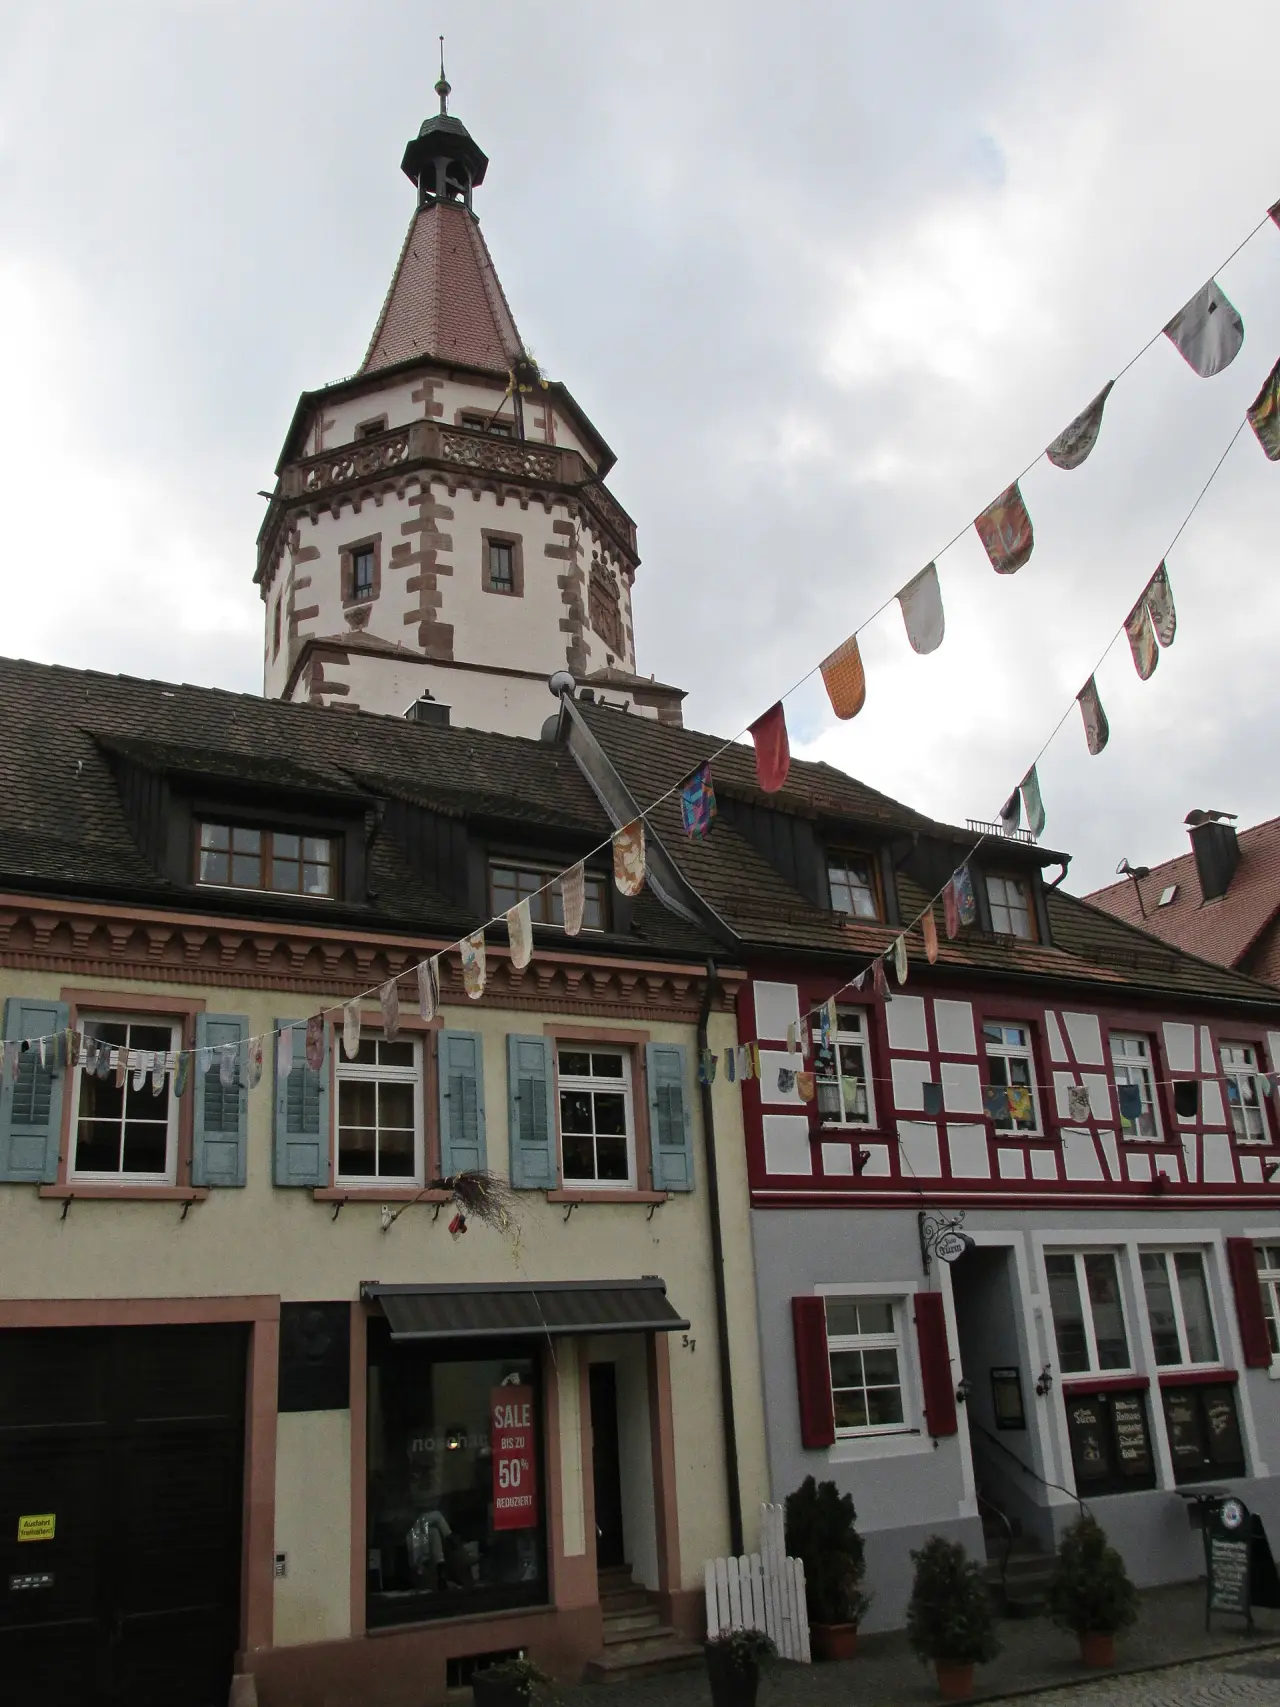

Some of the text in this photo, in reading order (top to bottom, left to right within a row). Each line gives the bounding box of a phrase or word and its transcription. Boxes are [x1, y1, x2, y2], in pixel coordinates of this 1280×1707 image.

[682, 1335, 696, 1354] 37
[494, 1404, 531, 1429] SALE
[501, 1436, 525, 1449] BIS ZU
[499, 1458, 529, 1489] 50%
[496, 1495, 533, 1509] REDUZIERT
[24, 1519, 51, 1528] Ausfahrt
